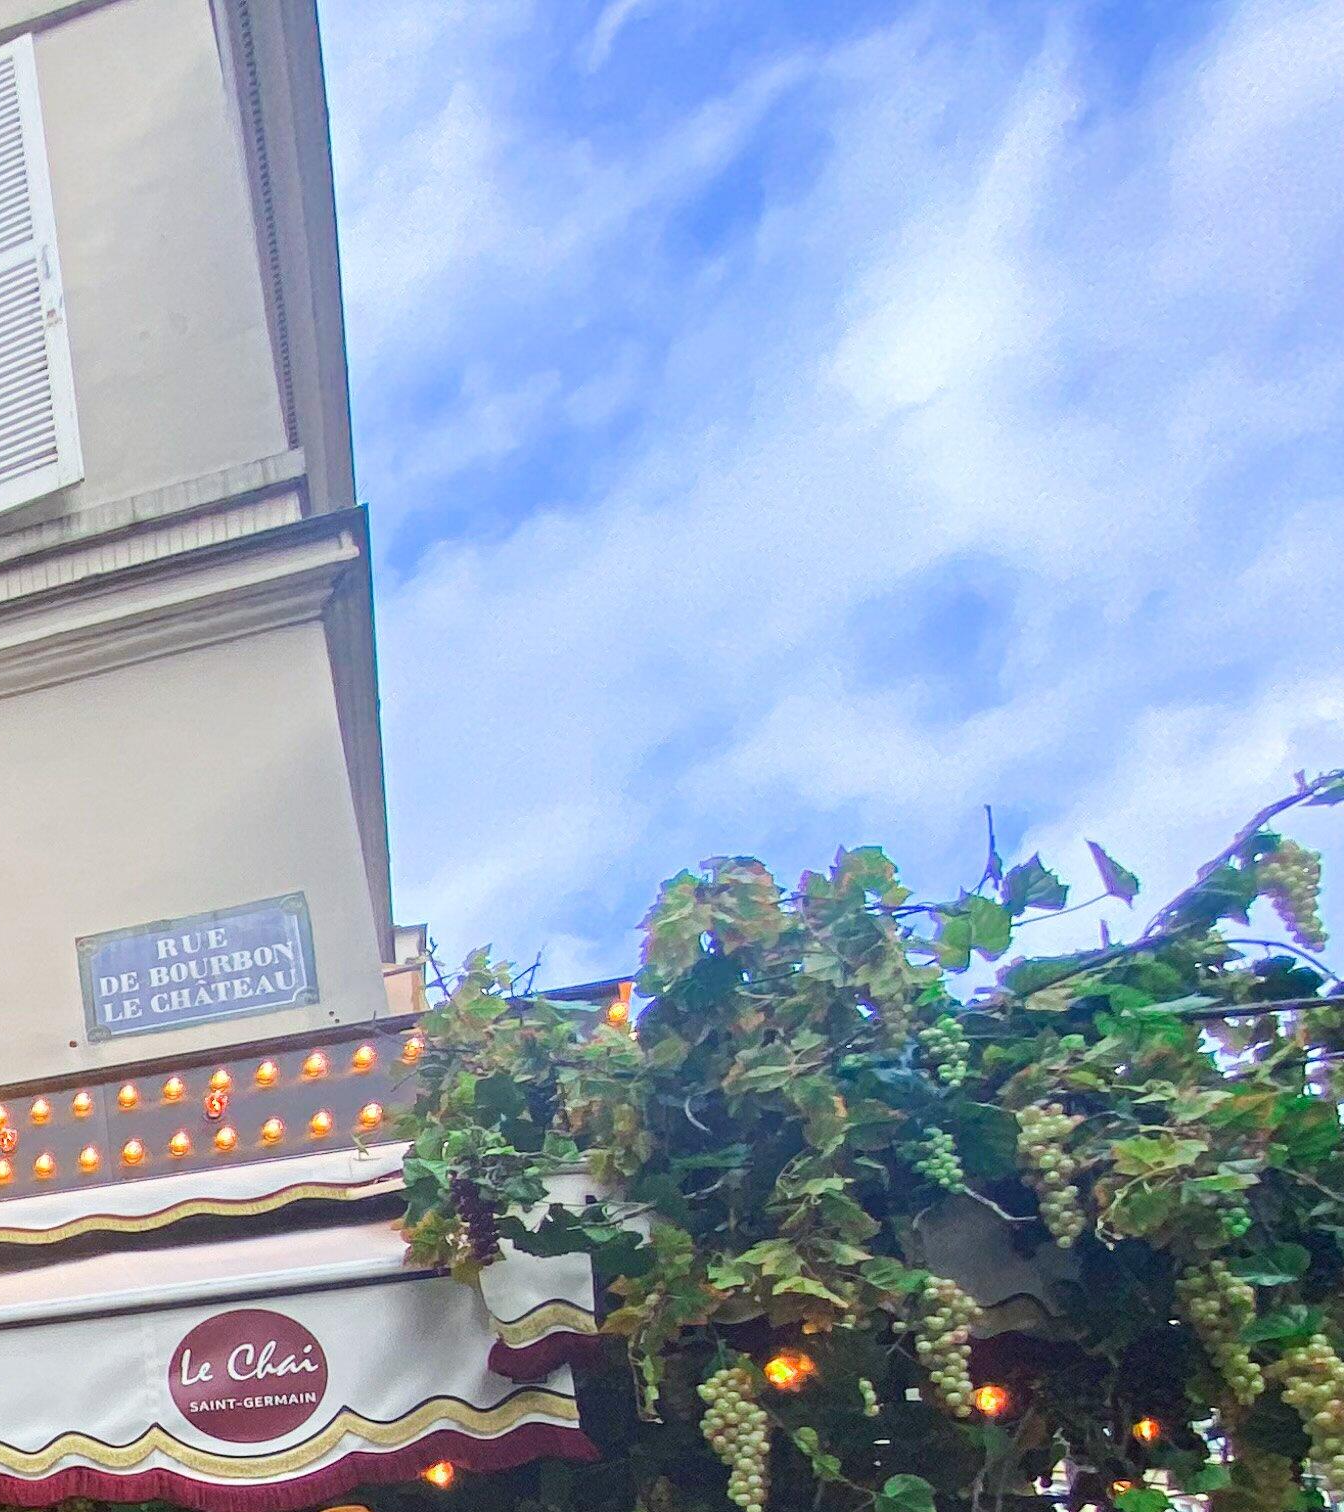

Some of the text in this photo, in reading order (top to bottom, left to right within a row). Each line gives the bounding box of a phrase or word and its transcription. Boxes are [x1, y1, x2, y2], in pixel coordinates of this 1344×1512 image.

[157, 928, 228, 960] RUE
[99, 941, 295, 997] DE BOURBON
[103, 969, 297, 1023] LE CHÂTEAU
[180, 1339, 319, 1387] Le Chai
[189, 1391, 317, 1413] SAINT-GERMAIN
